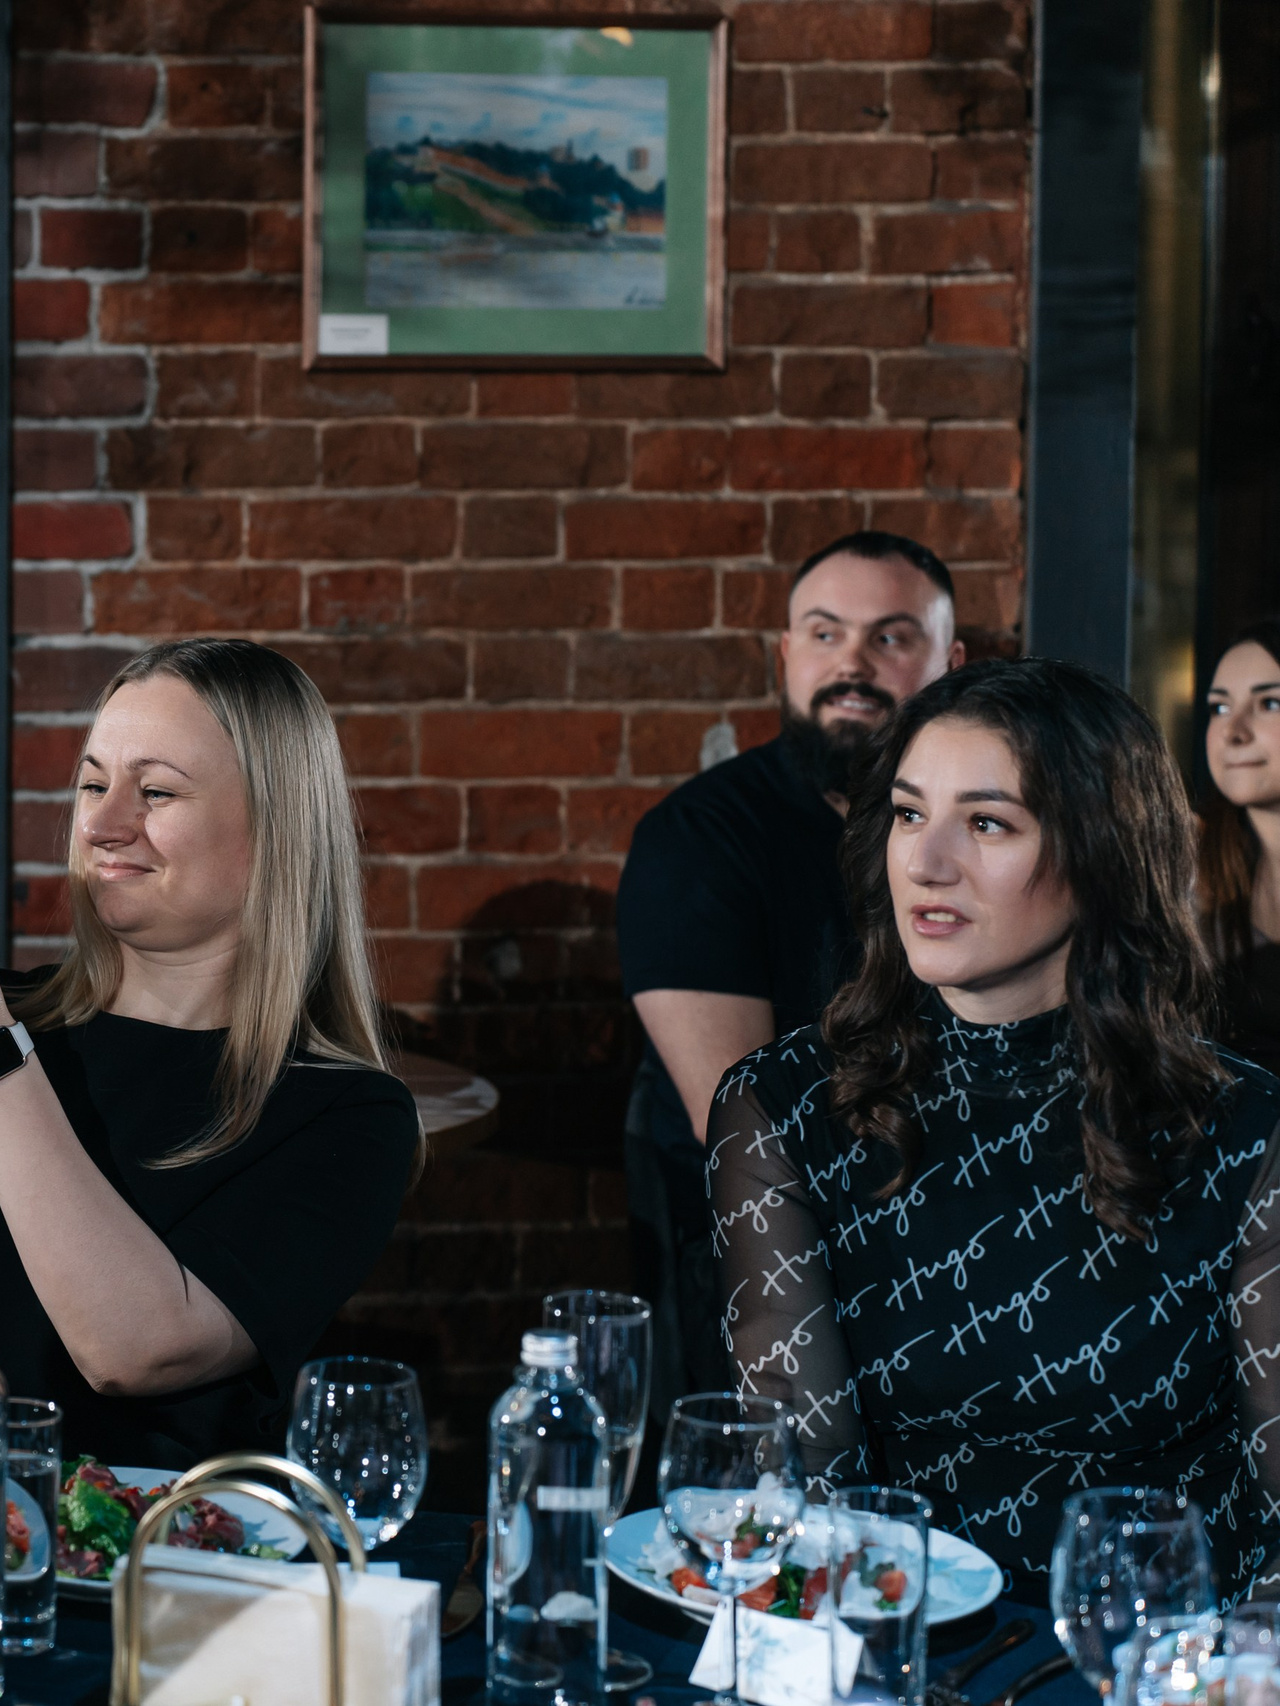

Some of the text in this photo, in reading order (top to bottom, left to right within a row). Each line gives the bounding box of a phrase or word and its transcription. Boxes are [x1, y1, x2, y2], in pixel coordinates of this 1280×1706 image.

[837, 1161, 944, 1254] Hugo
[953, 1088, 1069, 1188] Hugo
[711, 1180, 799, 1259] Hugo
[885, 1214, 1005, 1312] Hugo
[1013, 1173, 1095, 1241] Hug
[761, 1239, 833, 1296] Hug
[943, 1256, 1070, 1356] Hugo
[1013, 1304, 1137, 1404] Hugo
[1149, 1240, 1235, 1326] Hugo
[794, 1368, 861, 1439] Hug
[891, 1380, 1002, 1432] Hugo
[1088, 1328, 1199, 1435] Hugo
[1202, 1466, 1241, 1532] ugo
